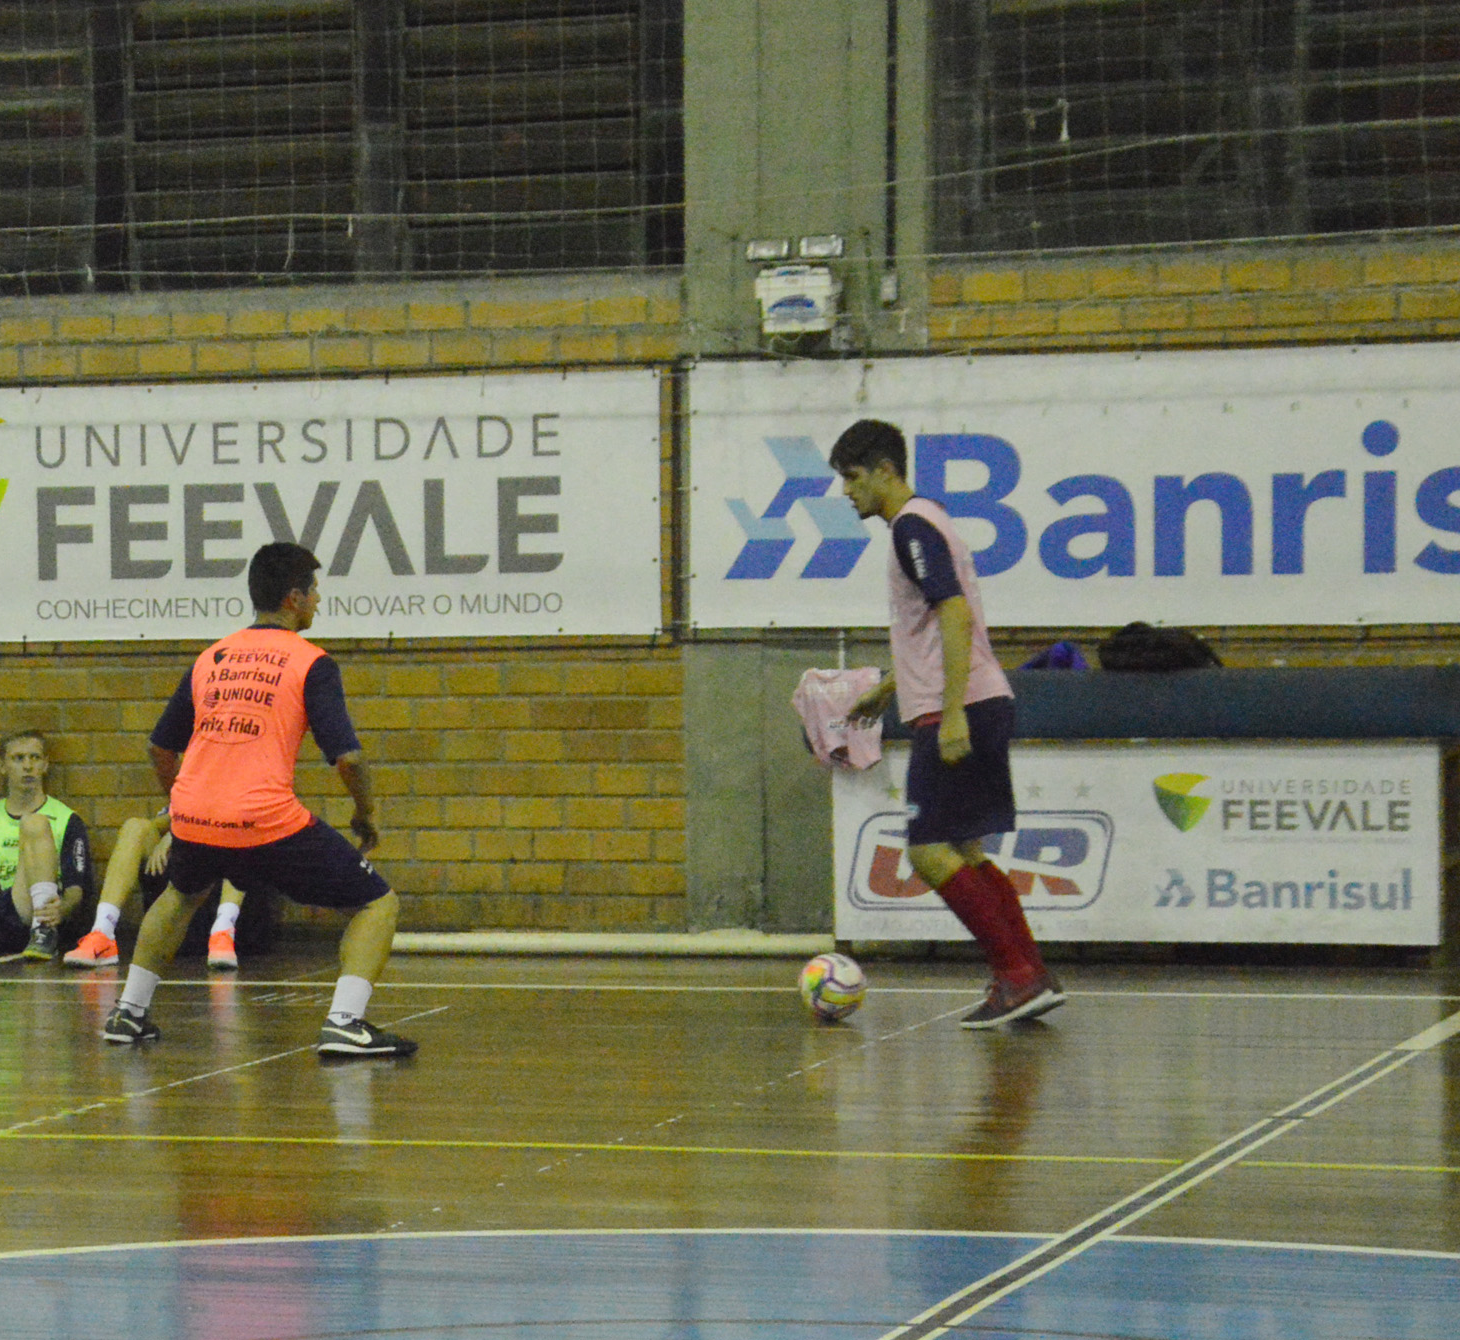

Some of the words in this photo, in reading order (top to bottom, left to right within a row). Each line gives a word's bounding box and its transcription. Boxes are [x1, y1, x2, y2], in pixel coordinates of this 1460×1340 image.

[35, 413, 561, 469] UNIVERSIDADE
[36, 475, 564, 581] FEEVALE
[36, 597, 244, 620] CONHECIMENTO
[328, 594, 424, 617] INOVAR
[433, 594, 452, 615] O
[459, 592, 564, 616] MUNDO
[229, 652, 288, 668] FEEVALE
[220, 667, 282, 686] Banrisul
[222, 687, 275, 707] UNIQUE
[1222, 778, 1412, 795] UNIVERSIDADE
[1222, 799, 1412, 832] FEEVALE
[869, 827, 1089, 898] UR
[1207, 868, 1412, 910] Banrisul
